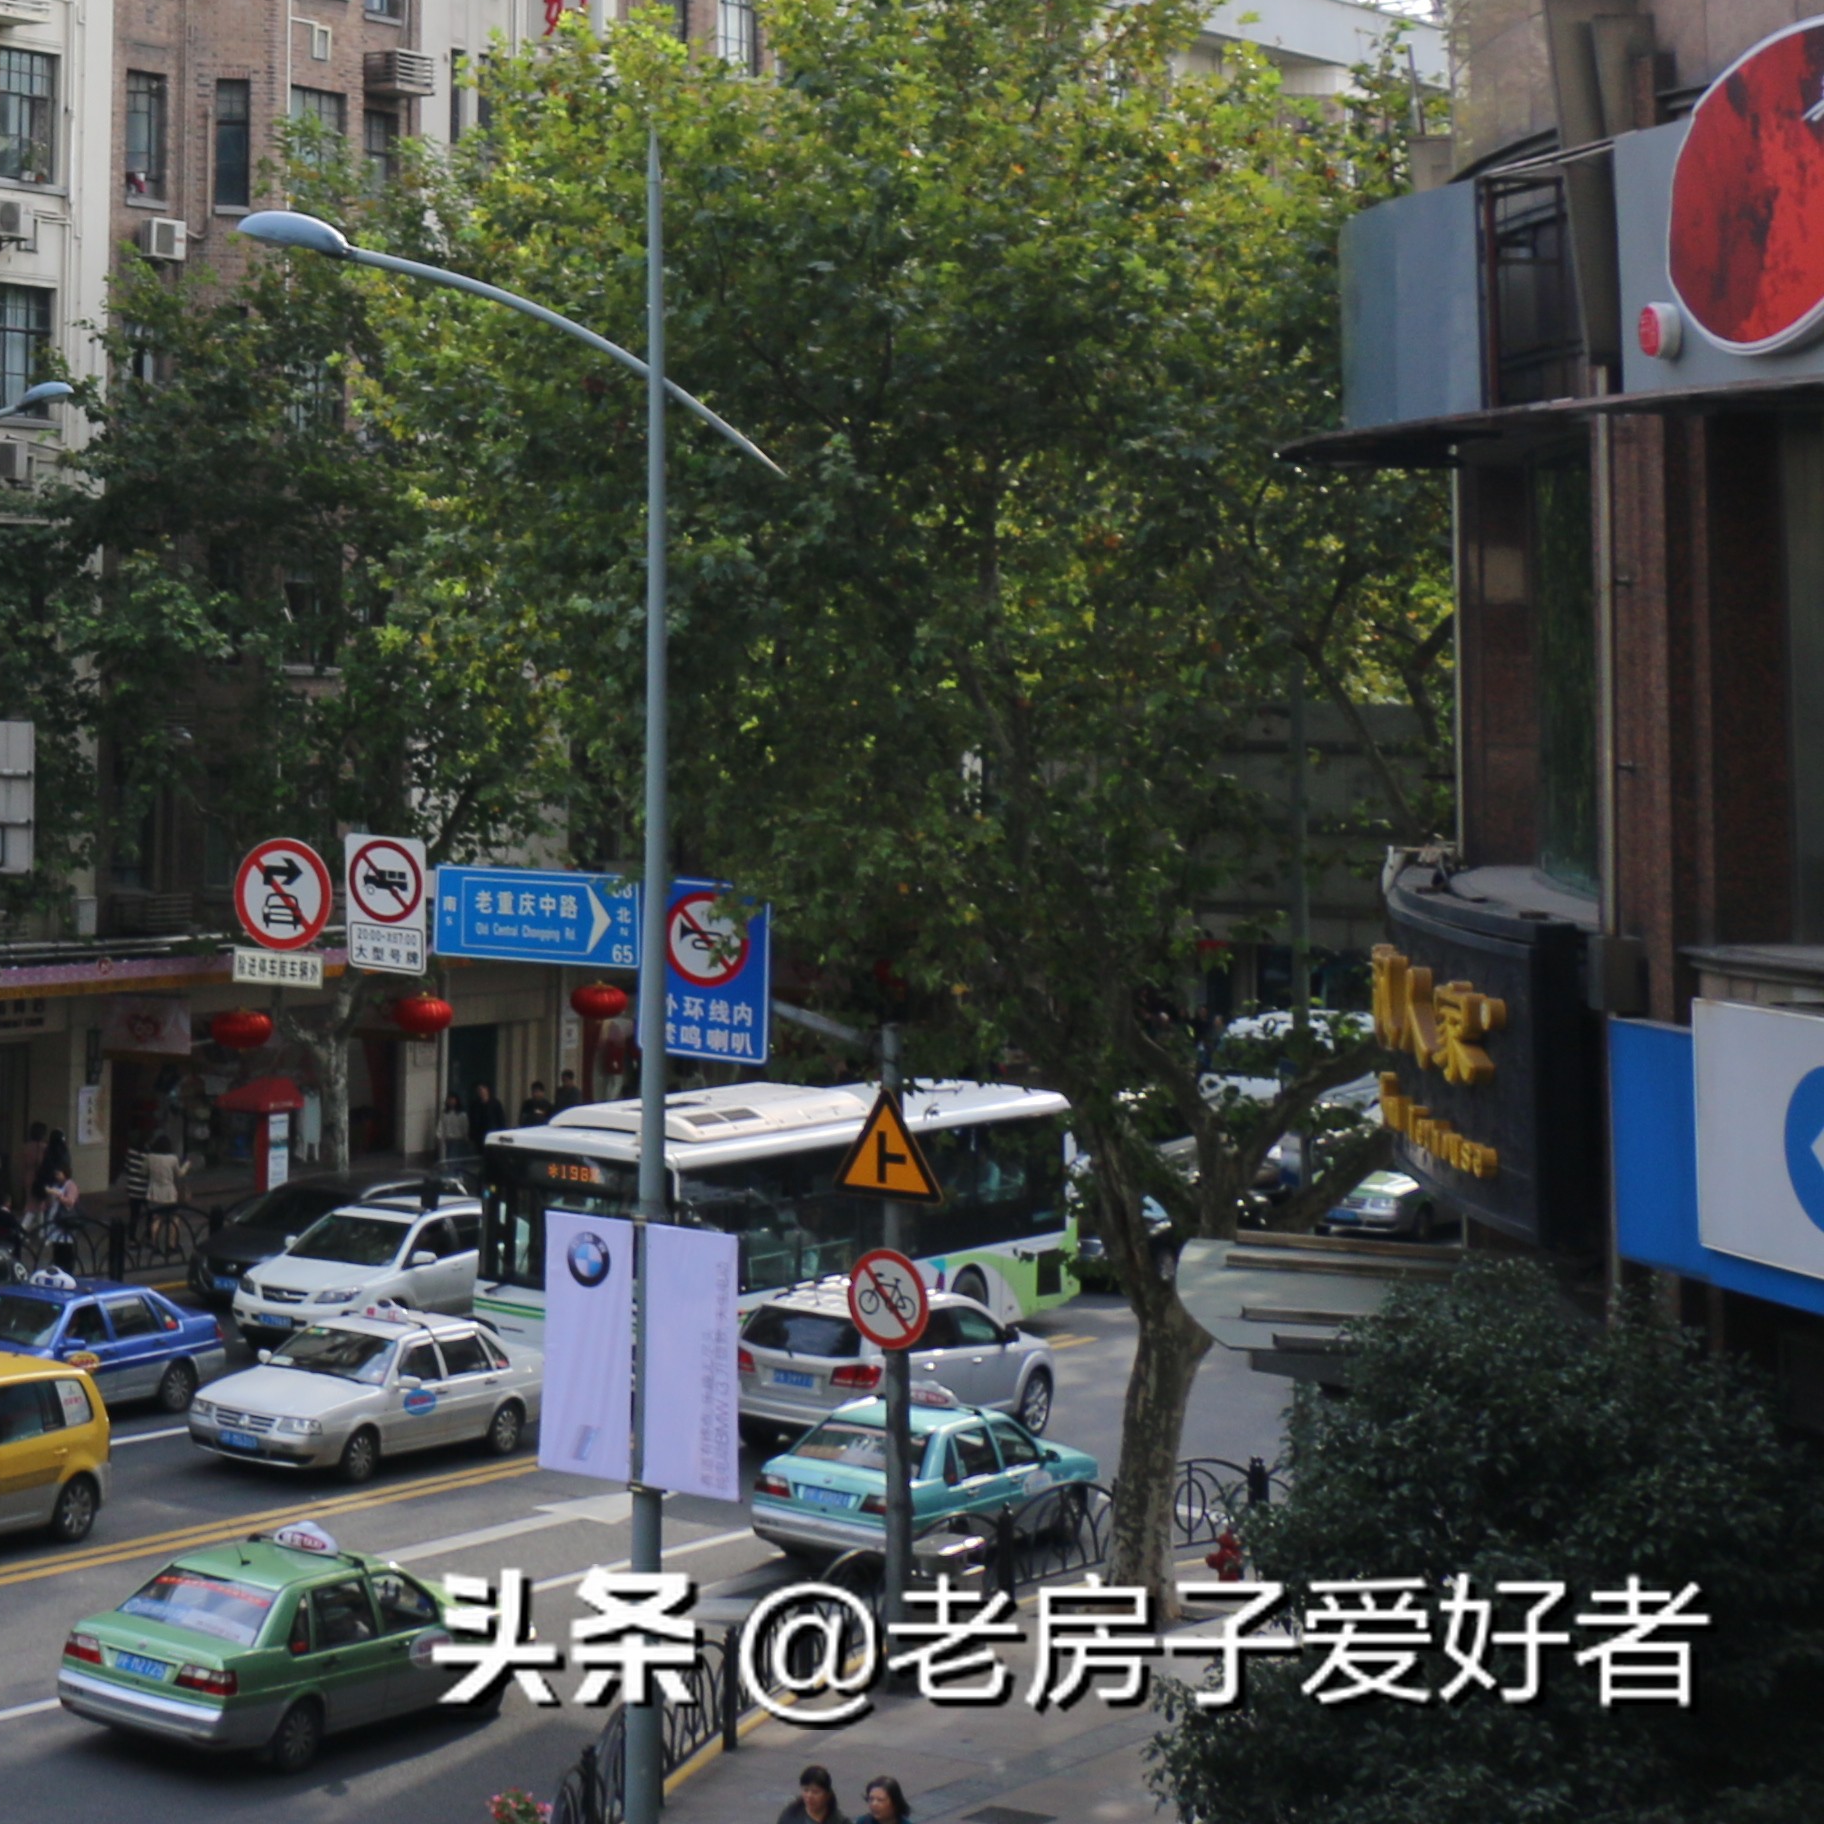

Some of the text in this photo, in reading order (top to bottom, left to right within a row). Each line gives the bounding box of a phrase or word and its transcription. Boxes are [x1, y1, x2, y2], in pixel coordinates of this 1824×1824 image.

[475, 890, 578, 919] 老重庆中路
[616, 907, 632, 924] 北
[354, 944, 419, 966] 大型号牌
[611, 943, 633, 964] 65
